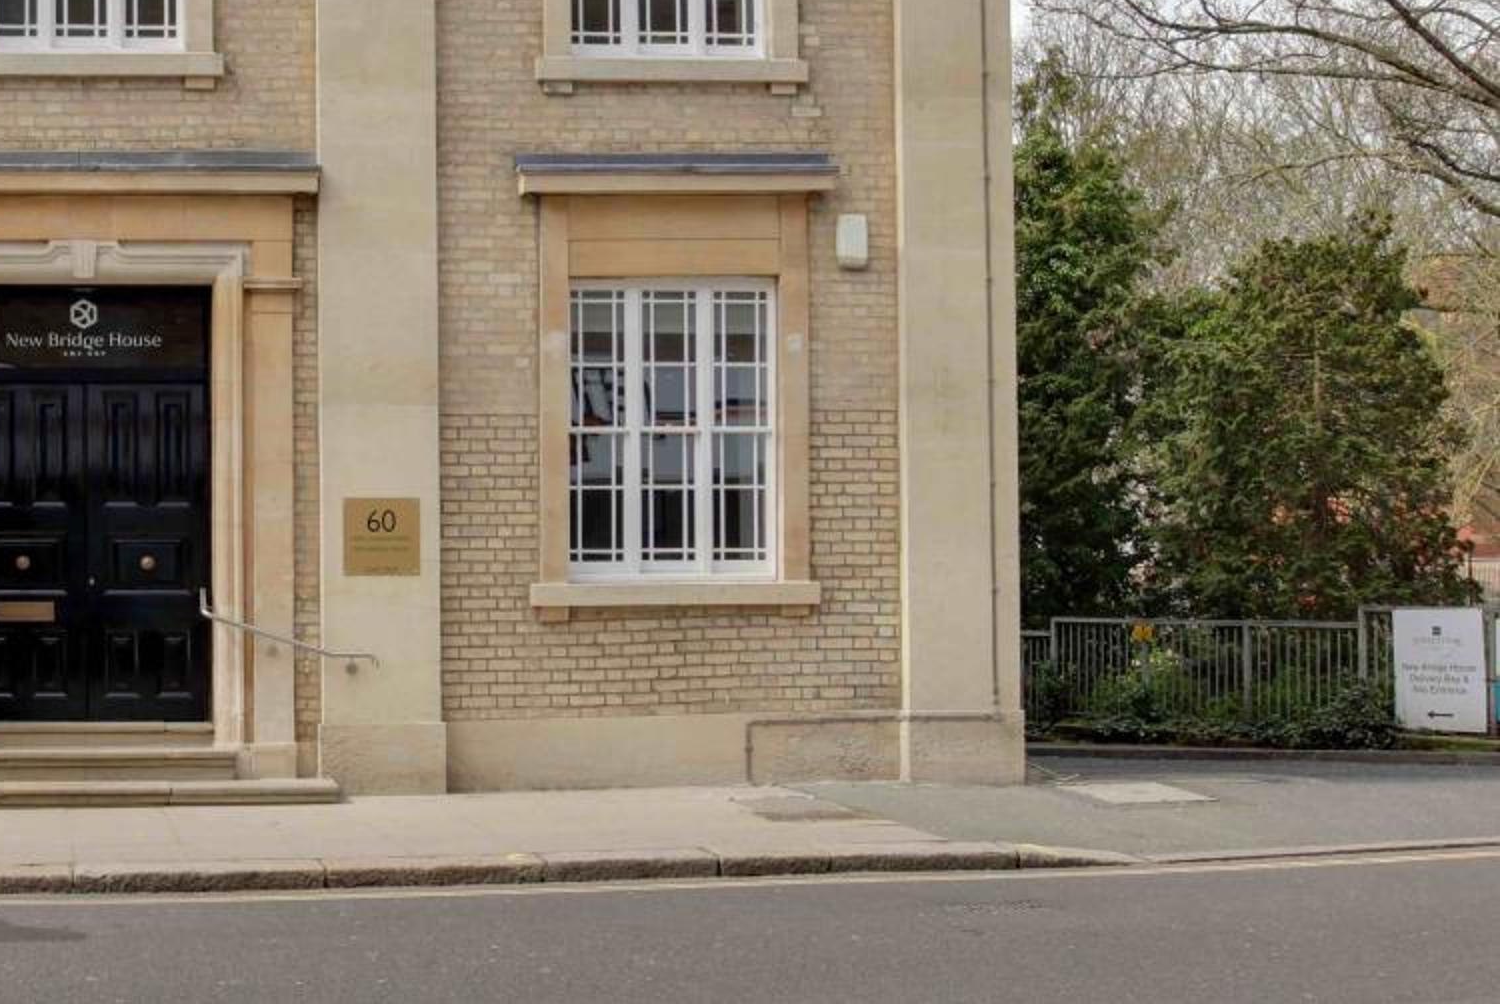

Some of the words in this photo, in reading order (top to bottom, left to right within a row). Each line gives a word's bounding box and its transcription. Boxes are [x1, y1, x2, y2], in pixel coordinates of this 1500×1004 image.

[5, 331, 44, 347] New
[48, 331, 105, 350] Bridge
[109, 331, 163, 347] House
[367, 509, 397, 533] 60
